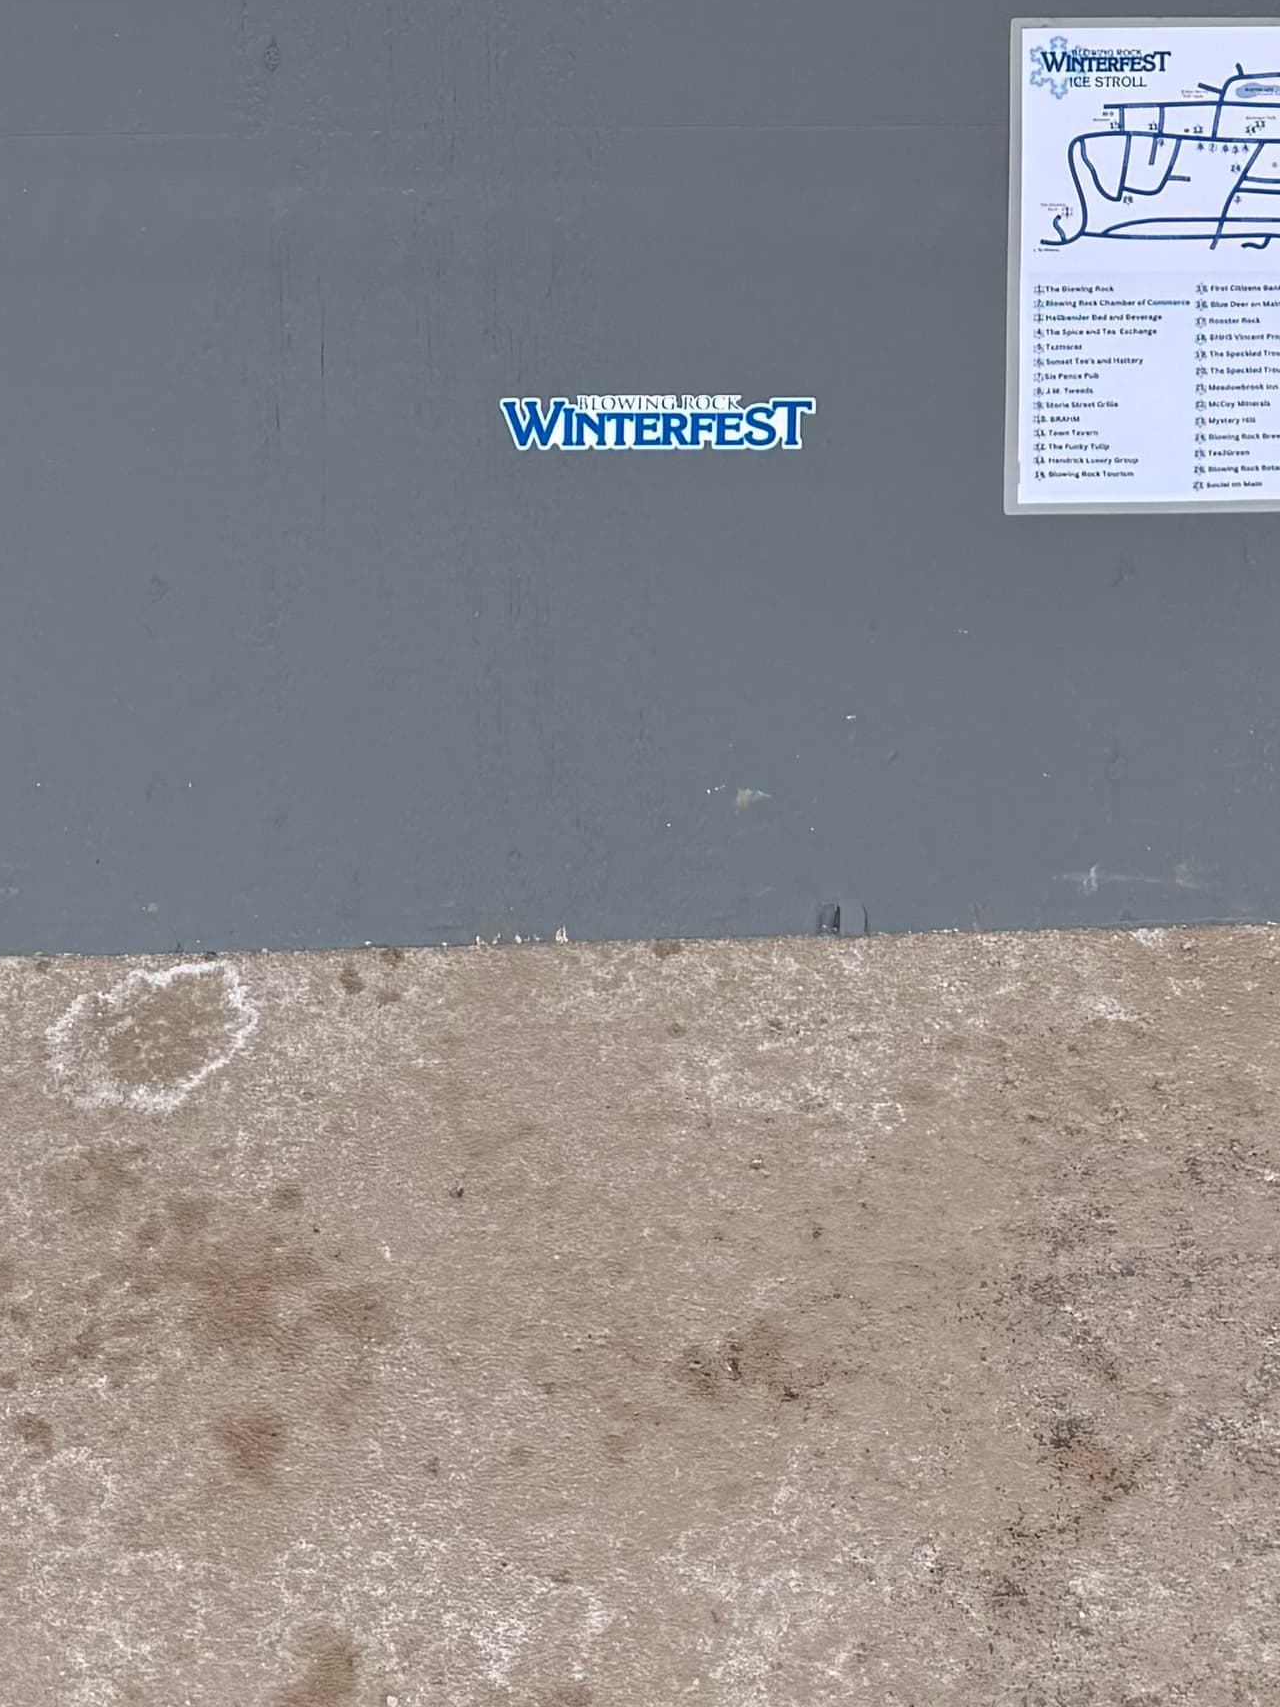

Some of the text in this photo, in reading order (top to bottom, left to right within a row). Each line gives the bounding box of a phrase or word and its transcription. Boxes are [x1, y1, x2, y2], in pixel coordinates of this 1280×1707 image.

[1041, 51, 1172, 73] WINTERFEST
[1069, 76, 1148, 88] ICE STROLL
[578, 395, 741, 412] BLOWING ROCK
[502, 400, 813, 447] WINTERFEST
